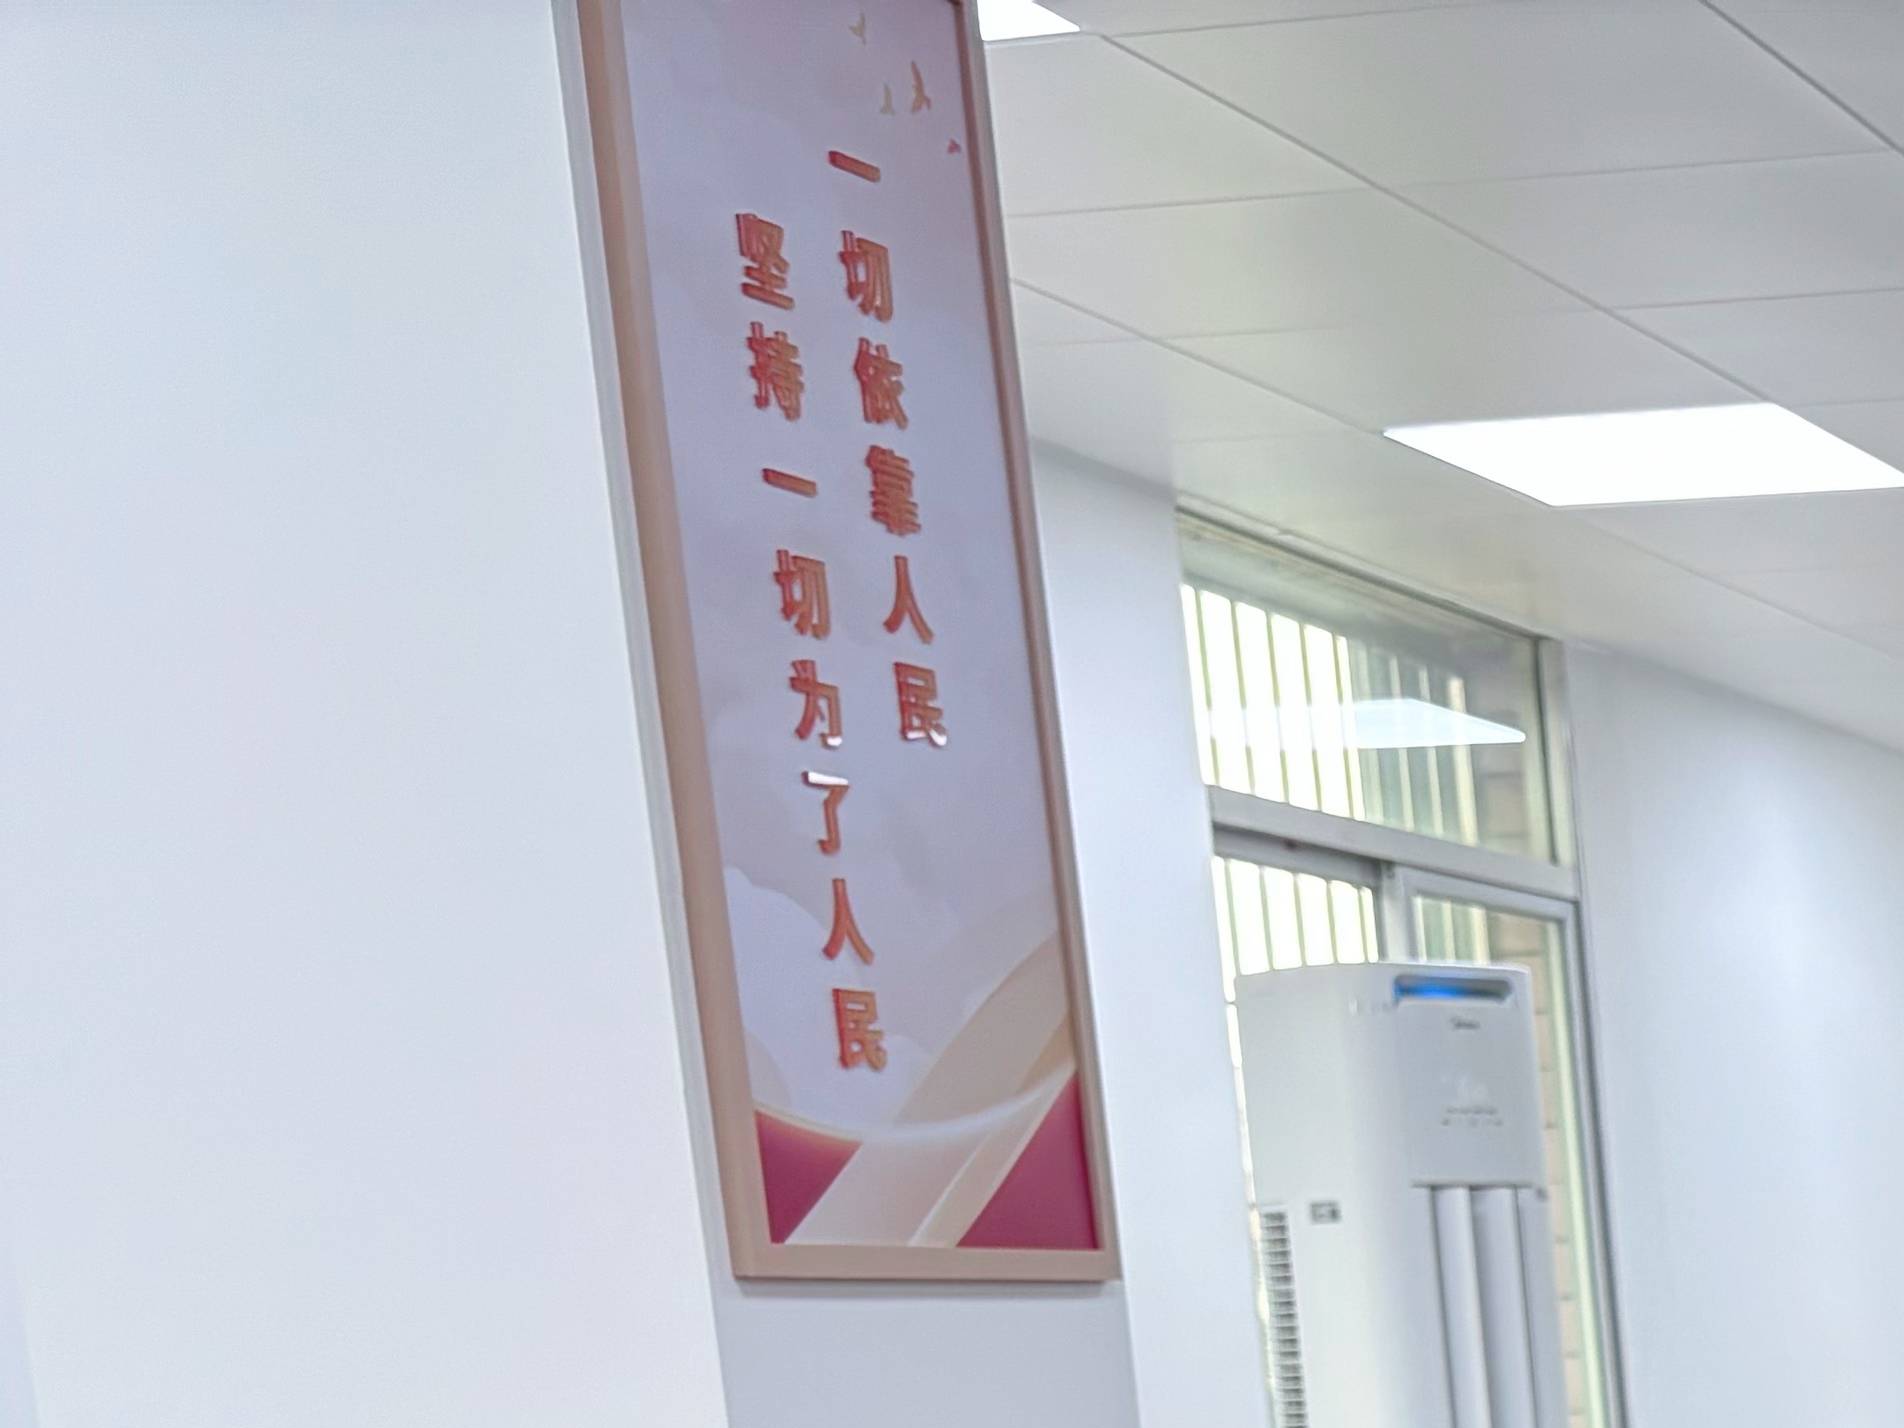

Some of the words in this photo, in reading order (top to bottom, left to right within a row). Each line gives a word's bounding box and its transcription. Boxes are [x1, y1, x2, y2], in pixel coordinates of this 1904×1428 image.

[735, 212, 887, 1073] 坚持一切为了人民
[828, 149, 948, 749] 一切依靠人民
